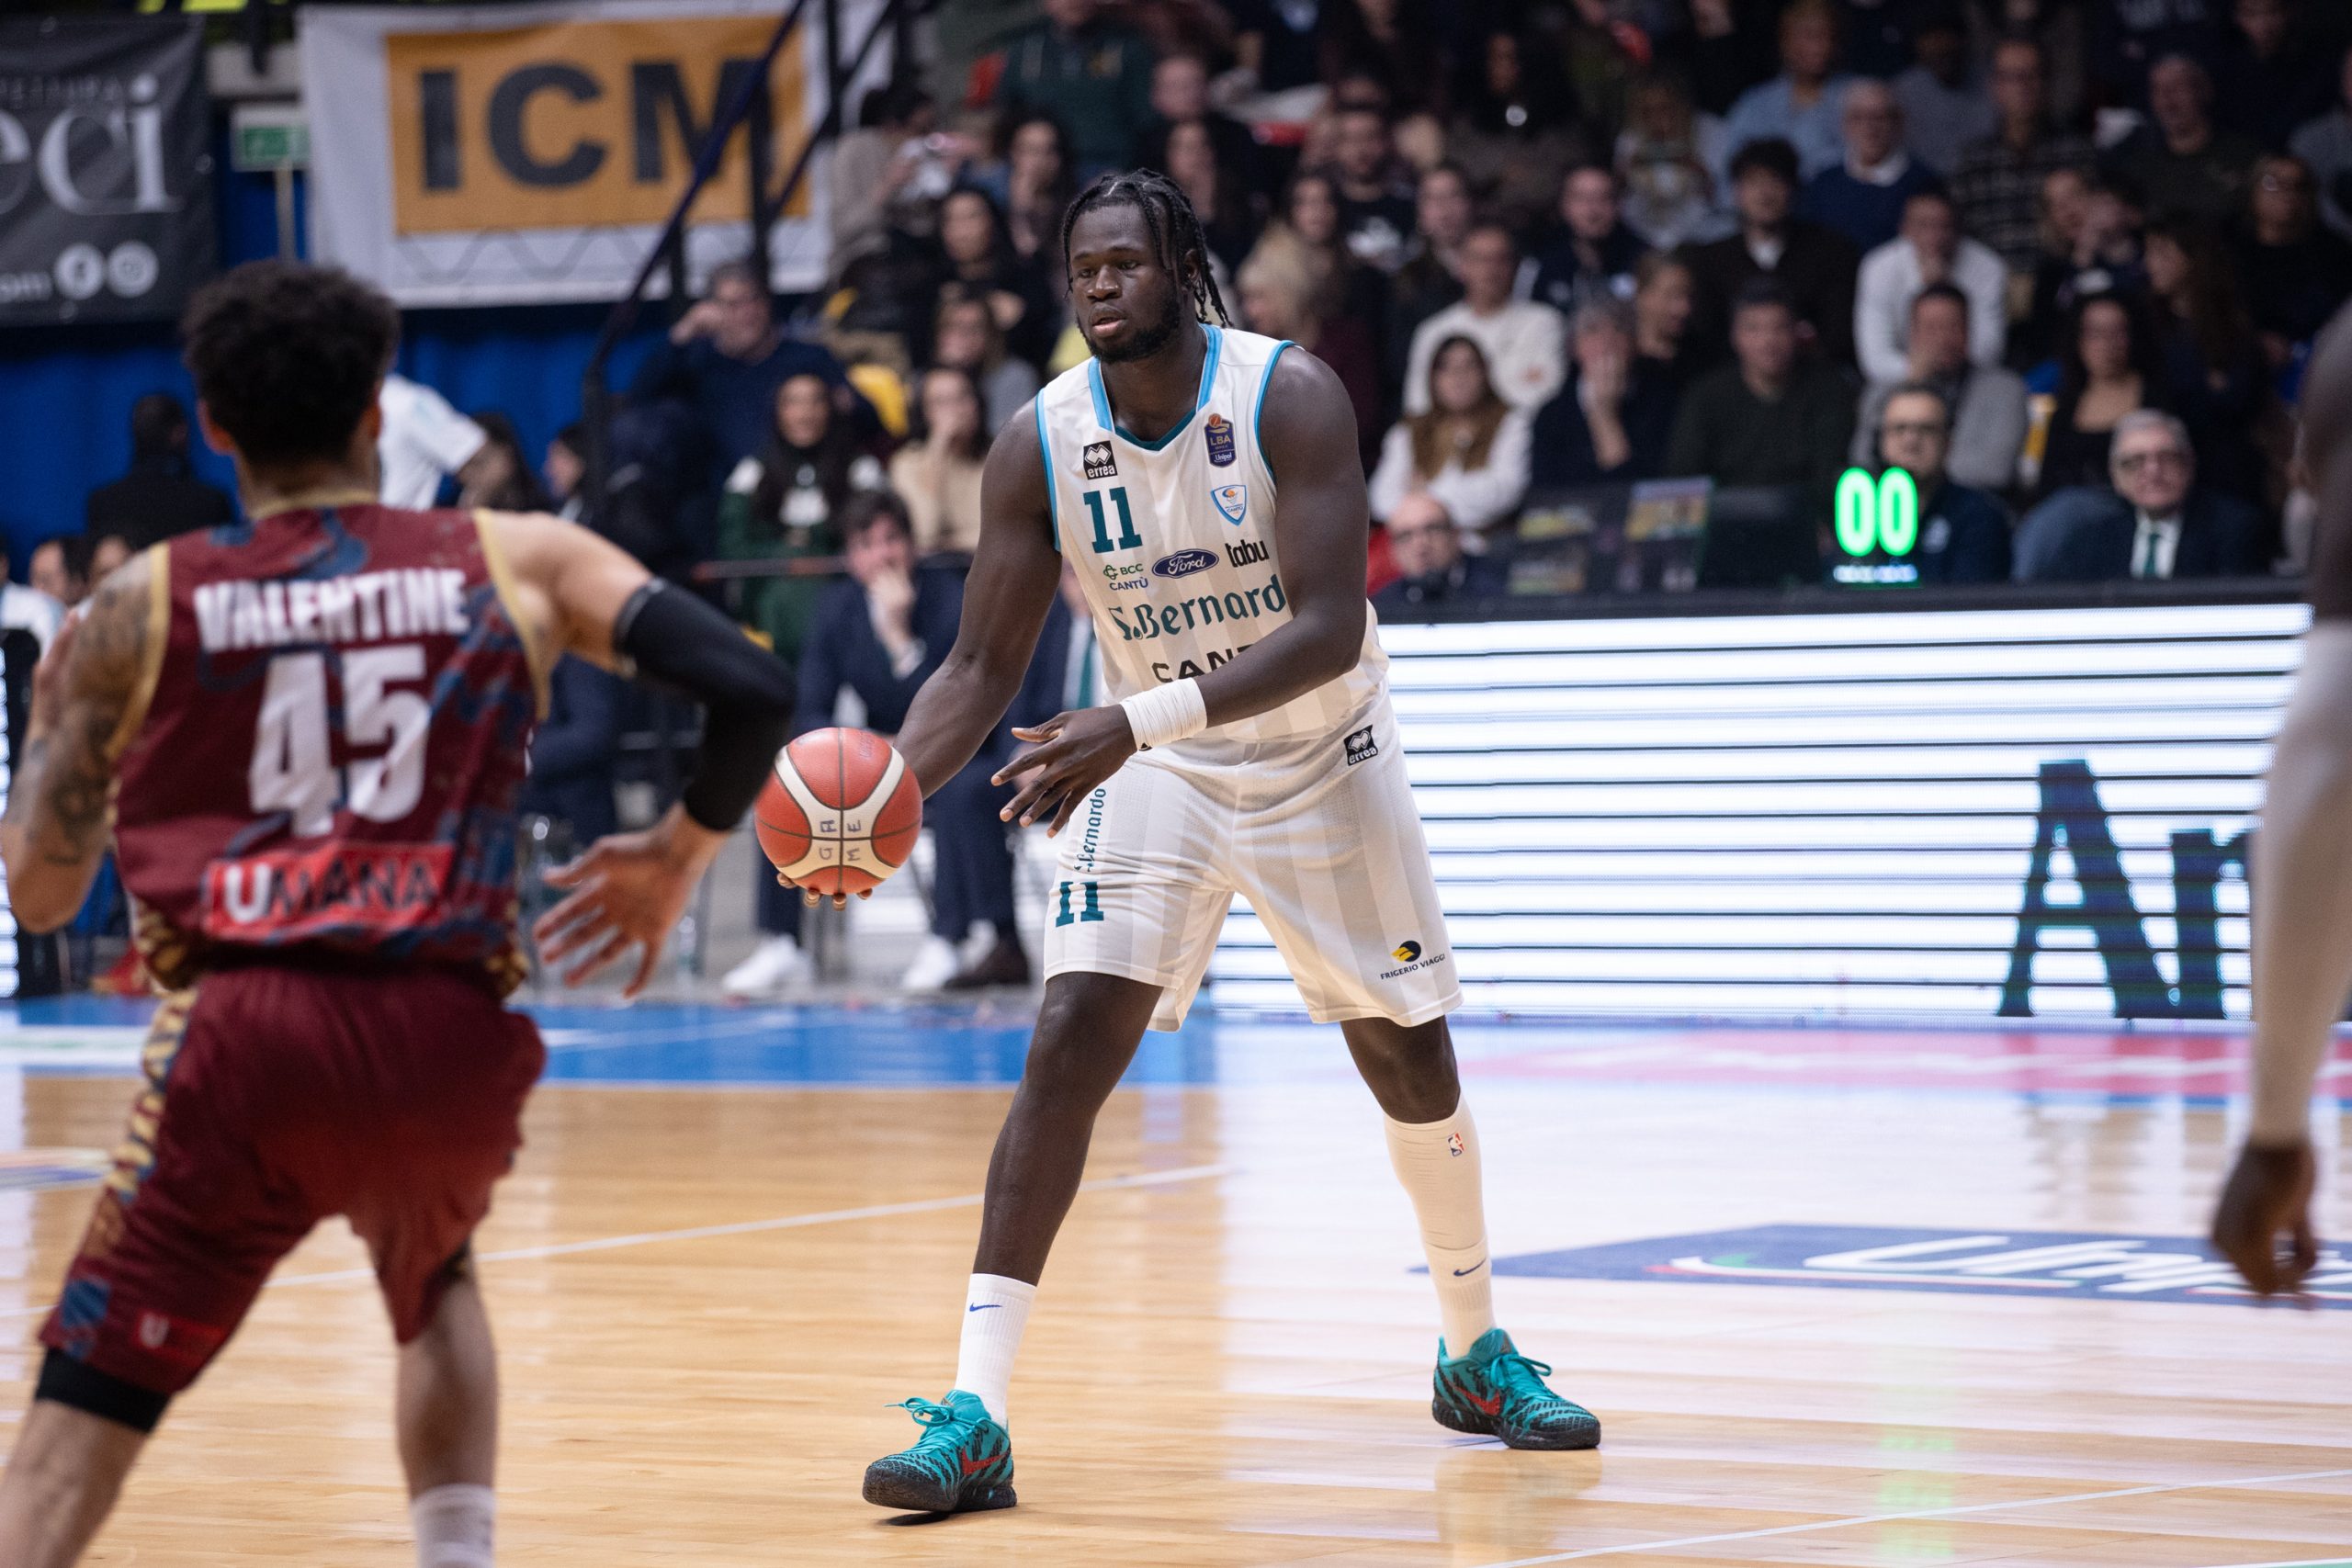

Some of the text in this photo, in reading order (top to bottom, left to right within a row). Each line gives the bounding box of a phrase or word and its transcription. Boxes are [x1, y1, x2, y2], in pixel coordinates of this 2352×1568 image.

[419, 58, 773, 193] ICM
[1210, 435, 1231, 446] LBA
[1215, 452, 1232, 462] Unipol
[1082, 486, 1143, 554] 11
[1835, 467, 1918, 557] 00
[1120, 563, 1144, 576] BCC
[1167, 553, 1206, 574] Ford
[1225, 539, 1270, 568] tabu
[1109, 578, 1148, 591] CANTÙ
[194, 568, 470, 652] VALENTINE
[1108, 573, 1286, 641] S.Bernard
[248, 643, 431, 837] 45
[1056, 881, 1104, 928] 11
[1380, 964, 1419, 979] FRIGERIO
